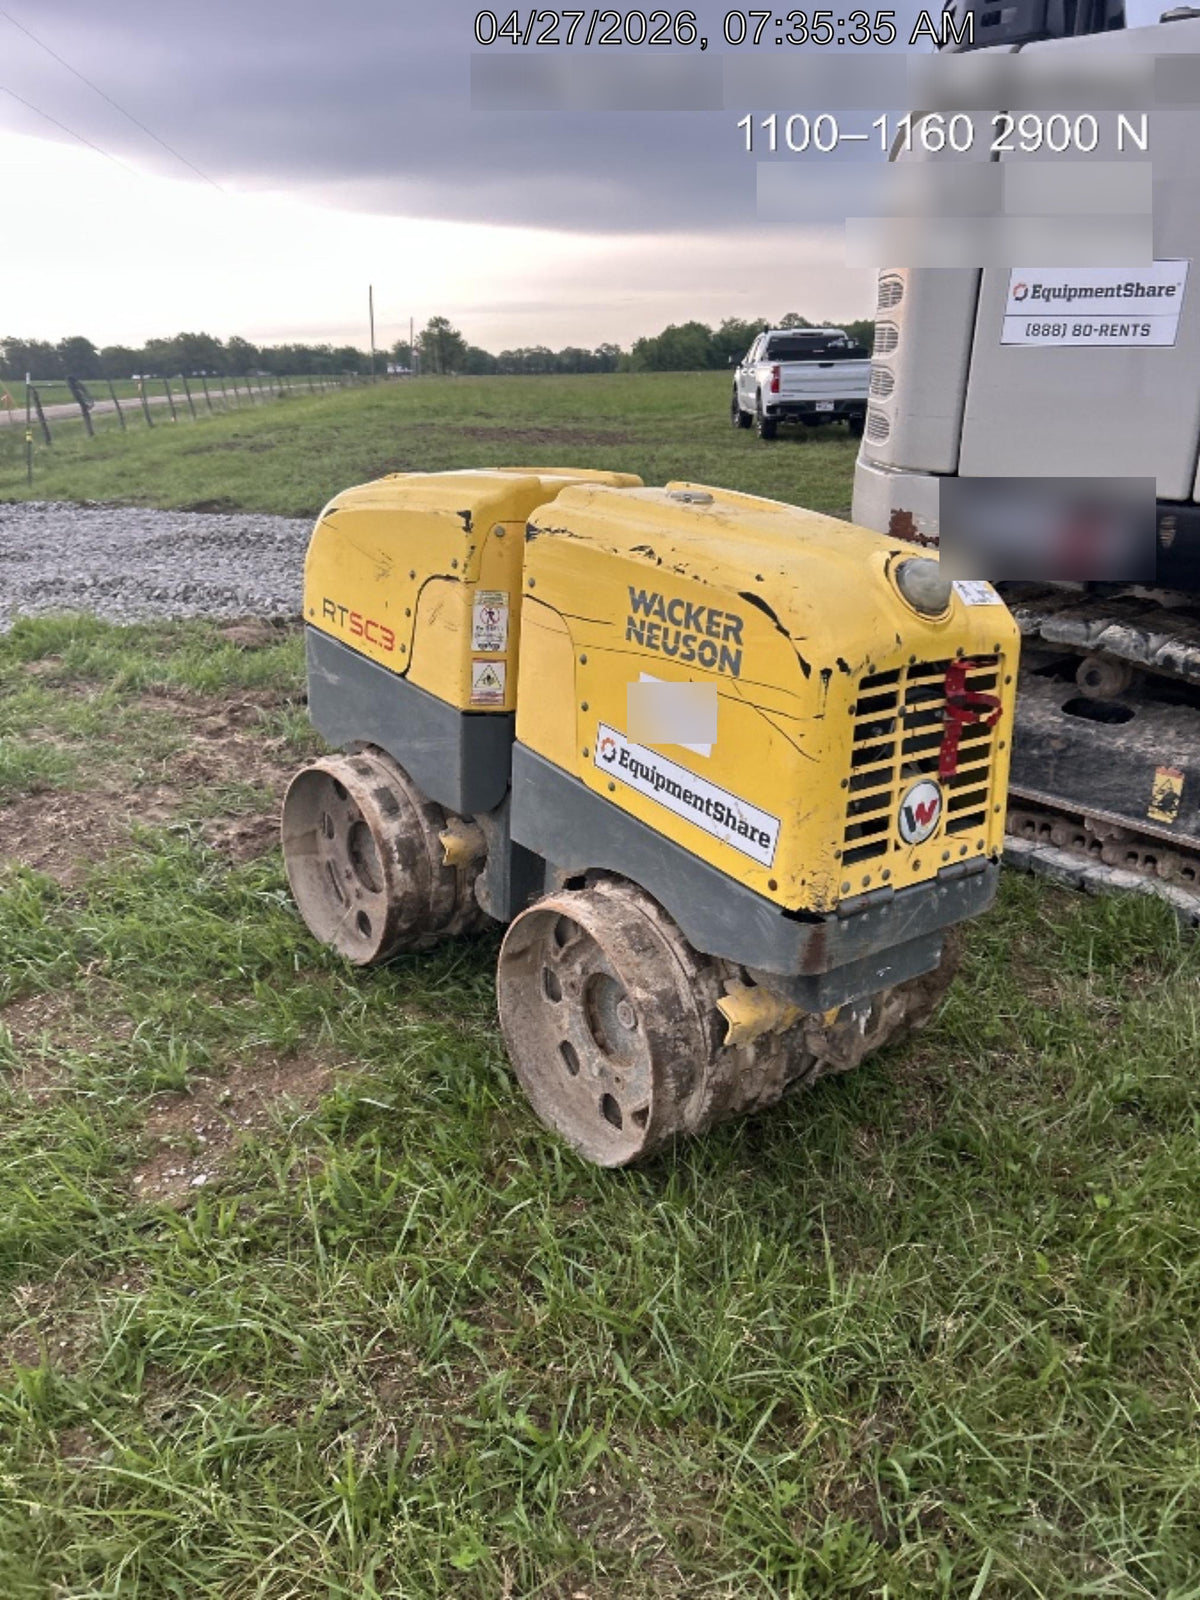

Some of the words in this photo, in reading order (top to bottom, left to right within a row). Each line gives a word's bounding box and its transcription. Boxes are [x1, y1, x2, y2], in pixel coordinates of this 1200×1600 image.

[1030, 282, 1176, 302] EquipmentShare
[1071, 323, 1152, 337] 80-RENTS
[625, 615, 743, 678] NEUSON
[628, 585, 744, 647] WACKER
[618, 747, 771, 849] EquipmentShare
